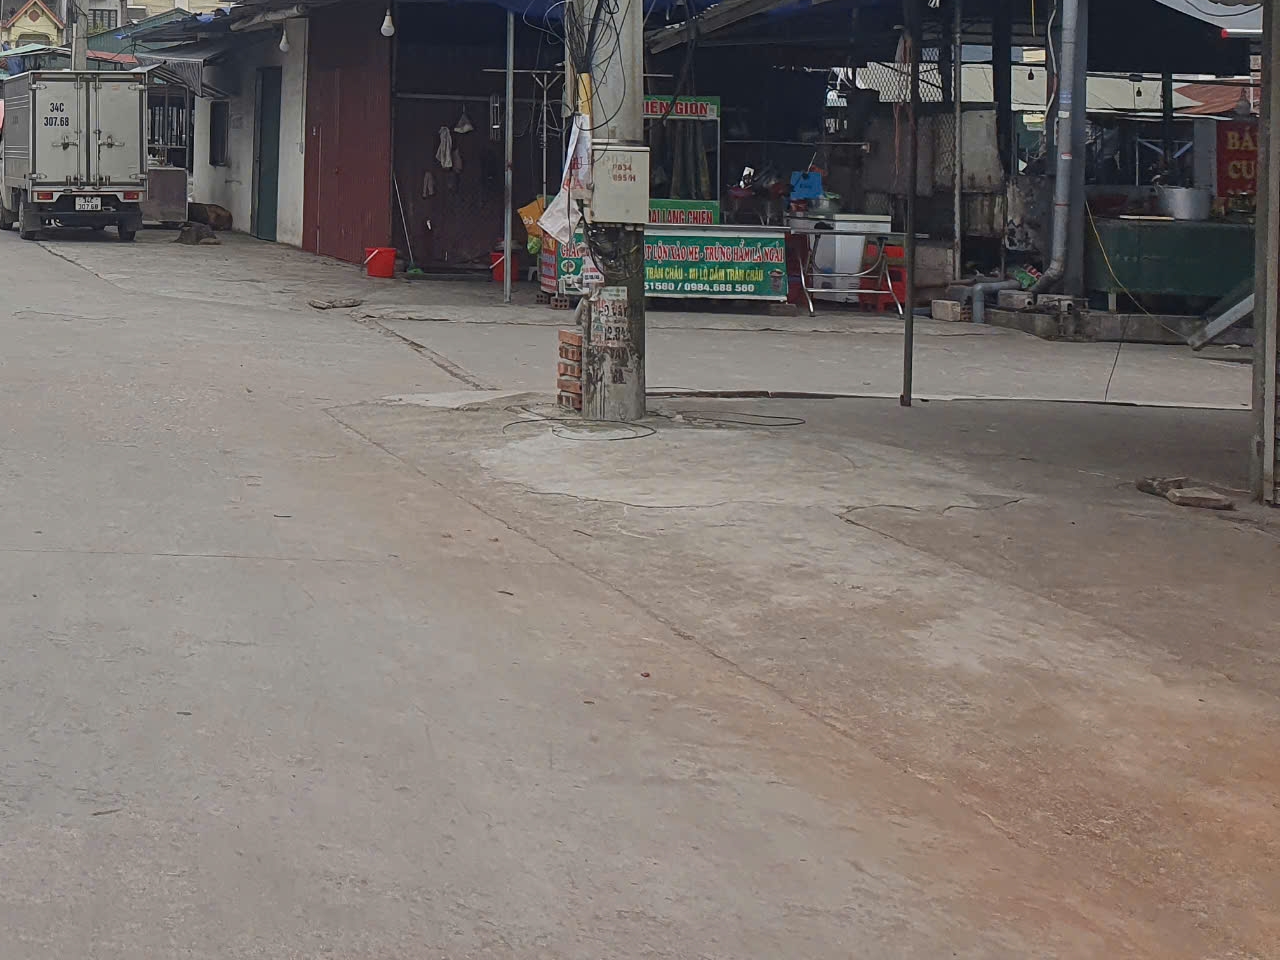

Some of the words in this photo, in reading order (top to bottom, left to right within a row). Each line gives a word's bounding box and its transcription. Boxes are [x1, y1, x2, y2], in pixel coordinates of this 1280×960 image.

[49, 102, 64, 113] 34C
[643, 98, 670, 115] IÊN
[43, 116, 70, 127] 307.68
[1227, 126, 1258, 150] BÁ
[1228, 160, 1255, 179] CU
[687, 246, 700, 261] ME
[665, 266, 683, 280] CHÂU
[644, 282, 675, 290] 51580
